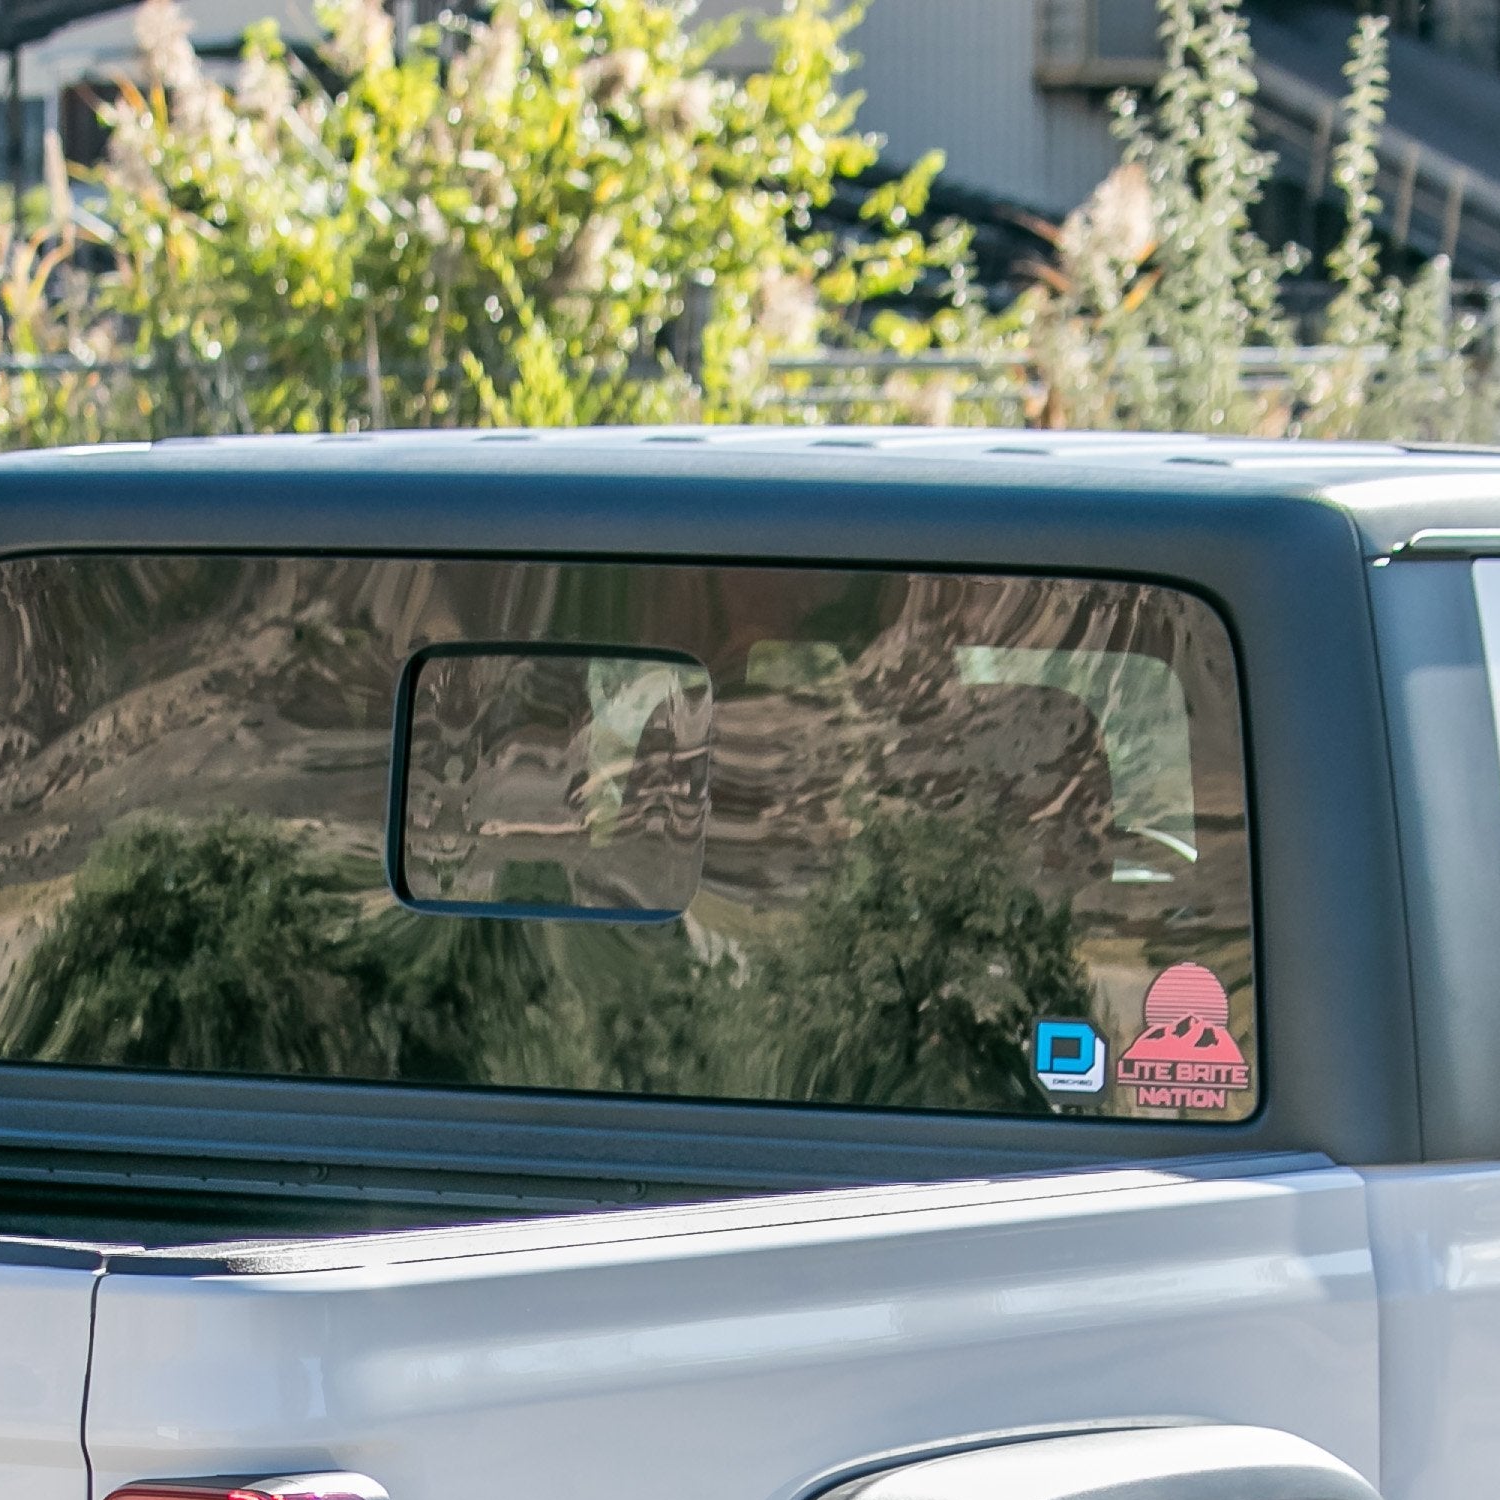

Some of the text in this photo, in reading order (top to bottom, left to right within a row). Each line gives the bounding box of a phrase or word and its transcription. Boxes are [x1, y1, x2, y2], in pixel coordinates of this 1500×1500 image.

[1118, 1060, 1249, 1083] LITE BRITE
[1139, 1087, 1225, 1108] NATION
